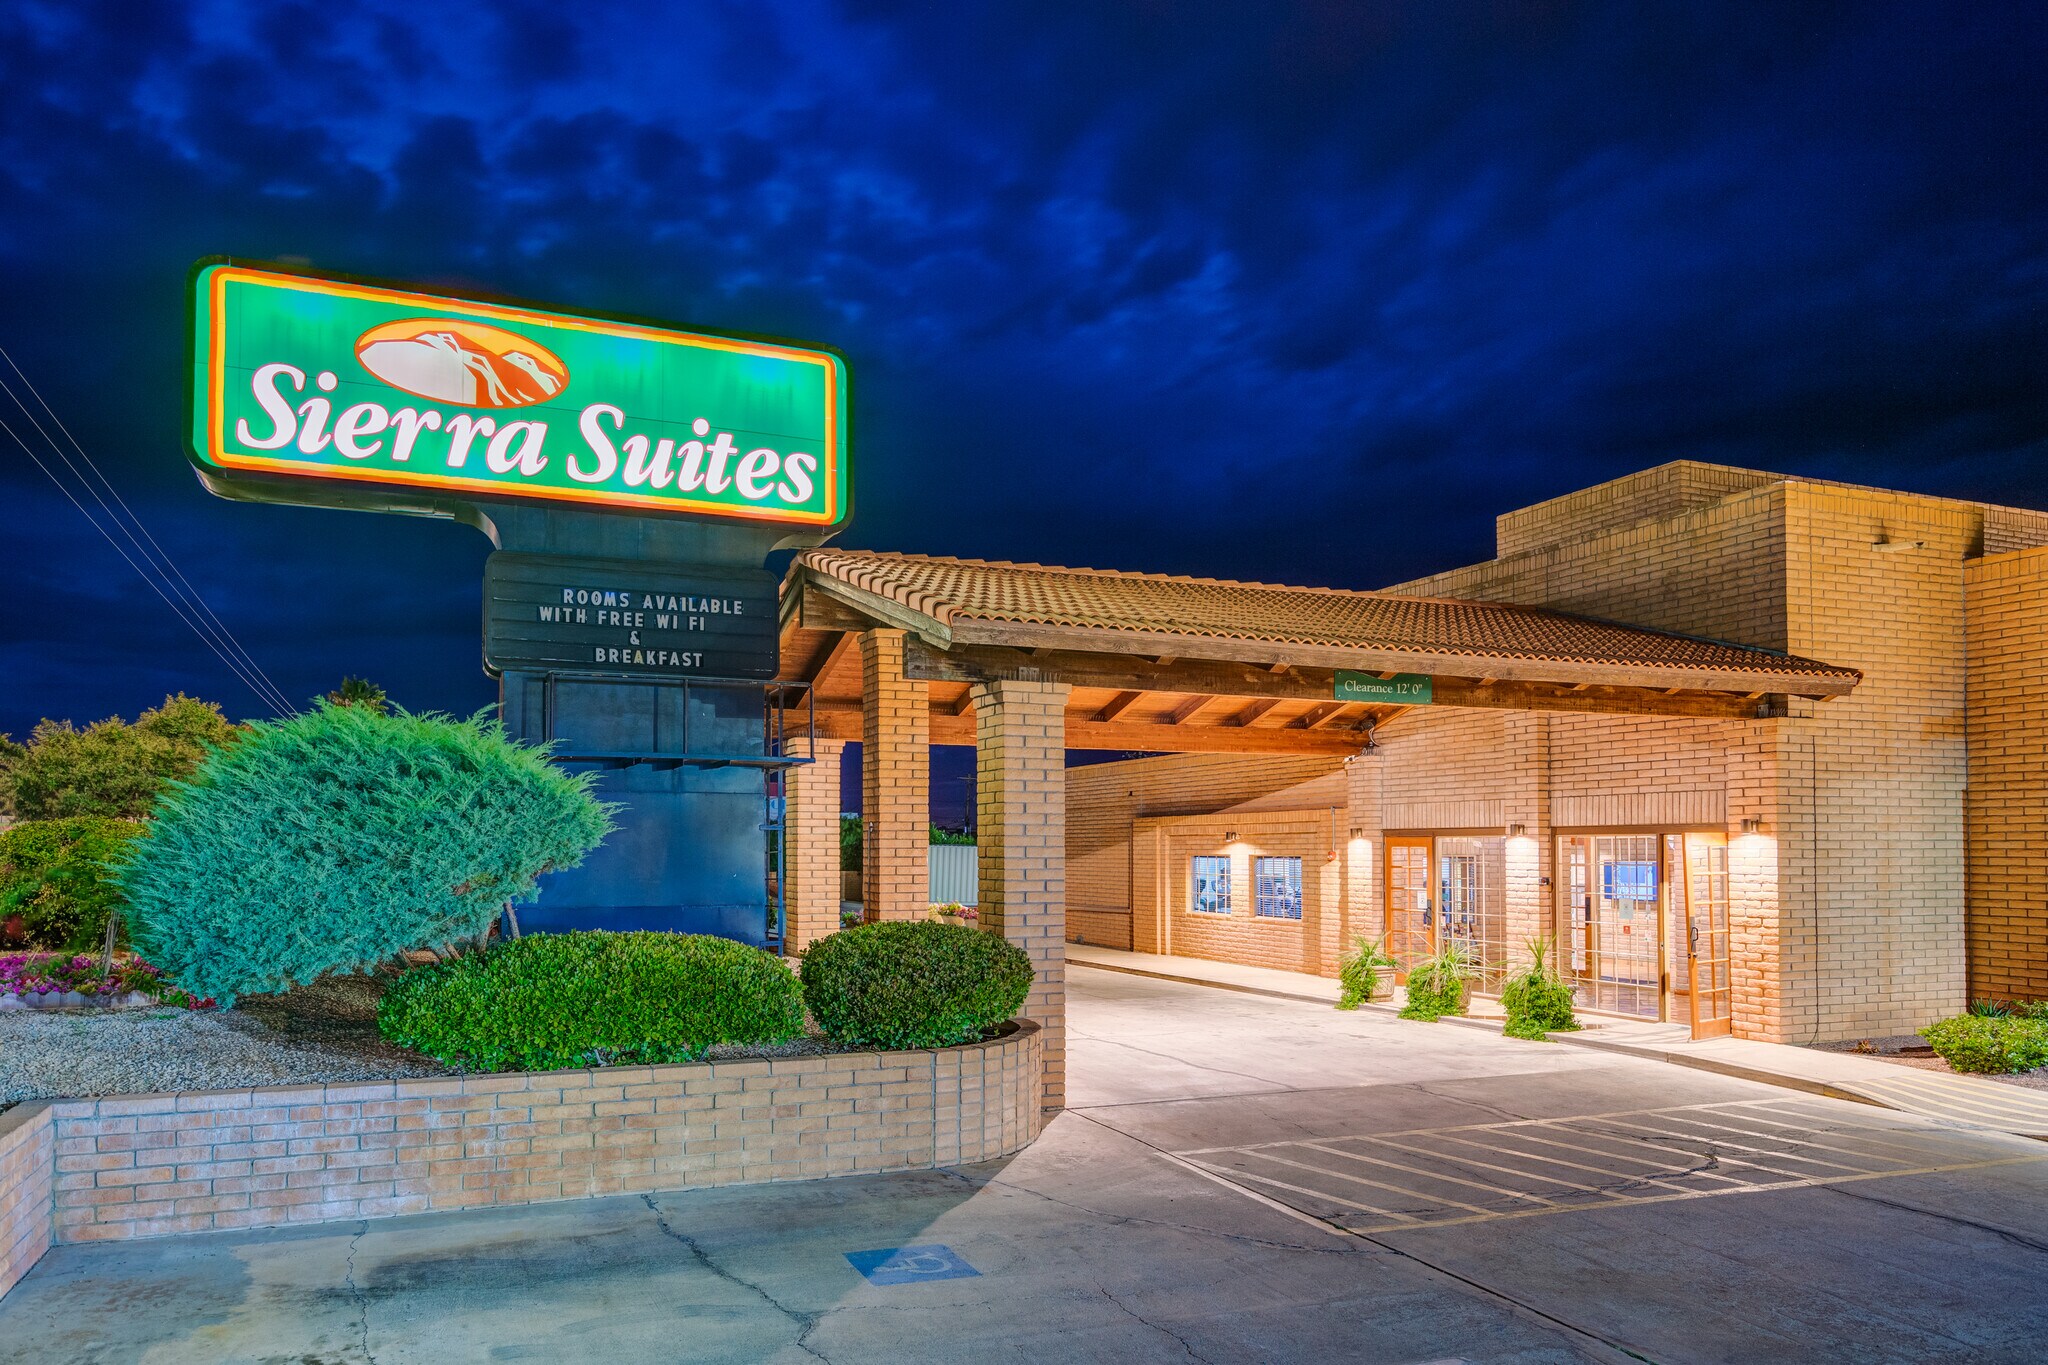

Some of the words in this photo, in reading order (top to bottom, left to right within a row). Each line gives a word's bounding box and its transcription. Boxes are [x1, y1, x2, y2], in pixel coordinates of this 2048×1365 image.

[236, 362, 549, 477] Sierra
[565, 402, 817, 504] Suites
[563, 588, 629, 607] ROOMS
[643, 594, 743, 615] AVAILABLE
[539, 606, 586, 623] WITH
[597, 610, 644, 627] FREE
[656, 614, 678, 629] WI
[688, 616, 705, 631] FI
[629, 630, 640, 645] &
[595, 647, 703, 667] BREAKFAST
[1344, 680, 1393, 693] Clearance
[1396, 683, 1410, 694] 12'
